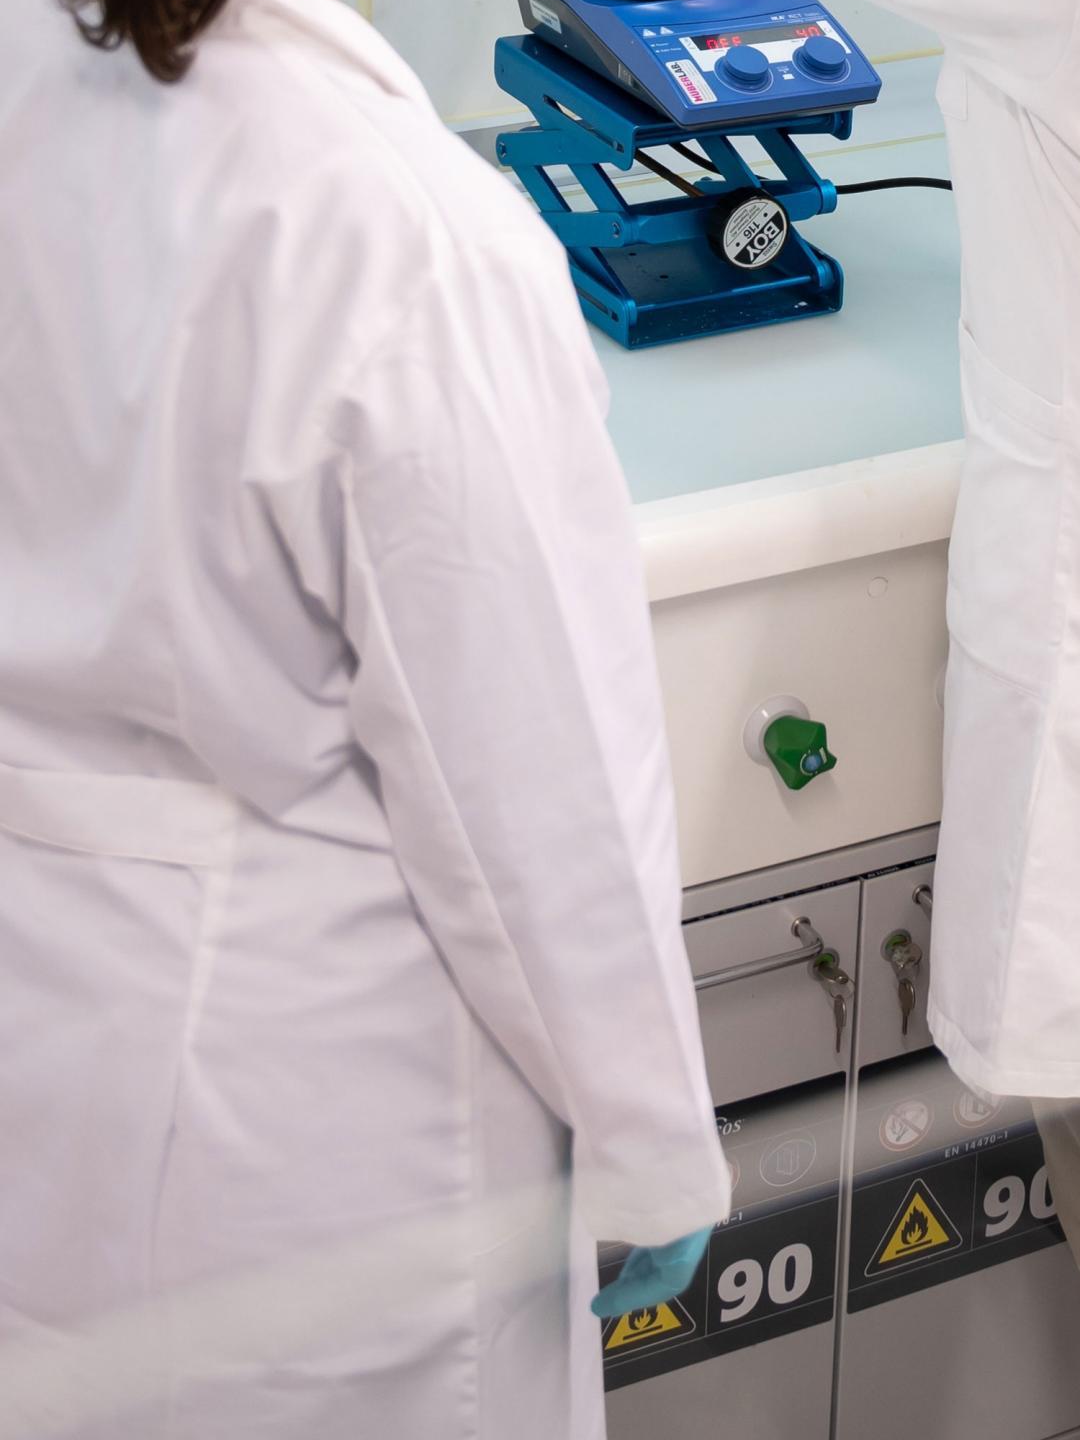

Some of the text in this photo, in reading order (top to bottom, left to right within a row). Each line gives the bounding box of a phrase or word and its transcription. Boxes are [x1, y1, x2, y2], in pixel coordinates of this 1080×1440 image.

[743, 221, 761, 240] 116
[746, 220, 781, 262] BOY
[944, 1146, 960, 1159] EN
[717, 1242, 813, 1324] 90
